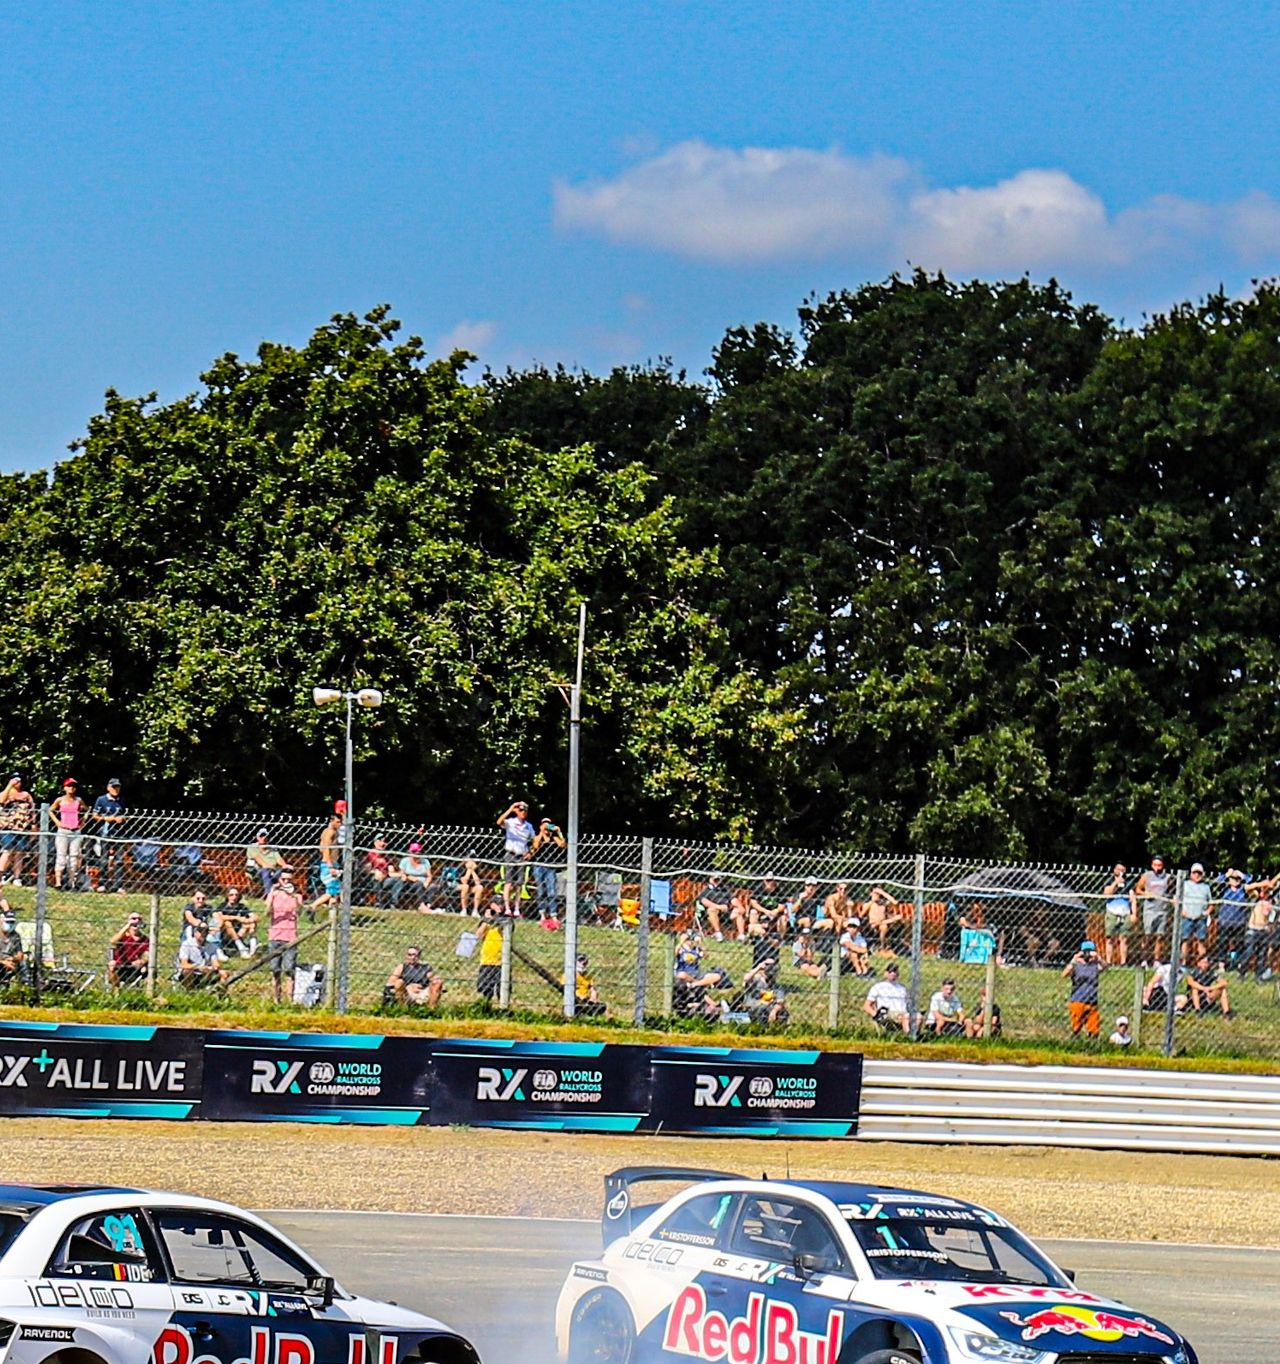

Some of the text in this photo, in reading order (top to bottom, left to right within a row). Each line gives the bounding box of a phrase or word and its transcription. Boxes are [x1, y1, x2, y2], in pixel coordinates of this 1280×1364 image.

[117, 1060, 186, 1091] LIVE
[308, 1062, 335, 1083] FIA
[338, 1063, 381, 1076] WORLD
[251, 1060, 304, 1094] RX
[337, 1076, 381, 1084] RALLYCROSS
[532, 1069, 558, 1090] FIA
[561, 1071, 603, 1083] WORLD
[776, 1077, 817, 1089] WORLD
[307, 1085, 381, 1096] CHAMPIONSHIP
[477, 1068, 528, 1100] RX
[559, 1083, 602, 1091] RALLYCROSS
[748, 1076, 773, 1097] FIA
[531, 1091, 601, 1102] CHAMPIONSHIP
[694, 1075, 744, 1107] RX
[775, 1090, 816, 1098] RALLYCROSS
[747, 1098, 815, 1109] CHAMPIONSHIP
[838, 1203, 889, 1219] RX
[949, 1209, 976, 1221] LIVE
[104, 1214, 145, 1252] 91
[876, 1225, 898, 1249] 1
[866, 1248, 948, 1261] KRISTOFFERSSON
[126, 1264, 149, 1283] IDE
[24, 1328, 72, 1339] RAVENOL
